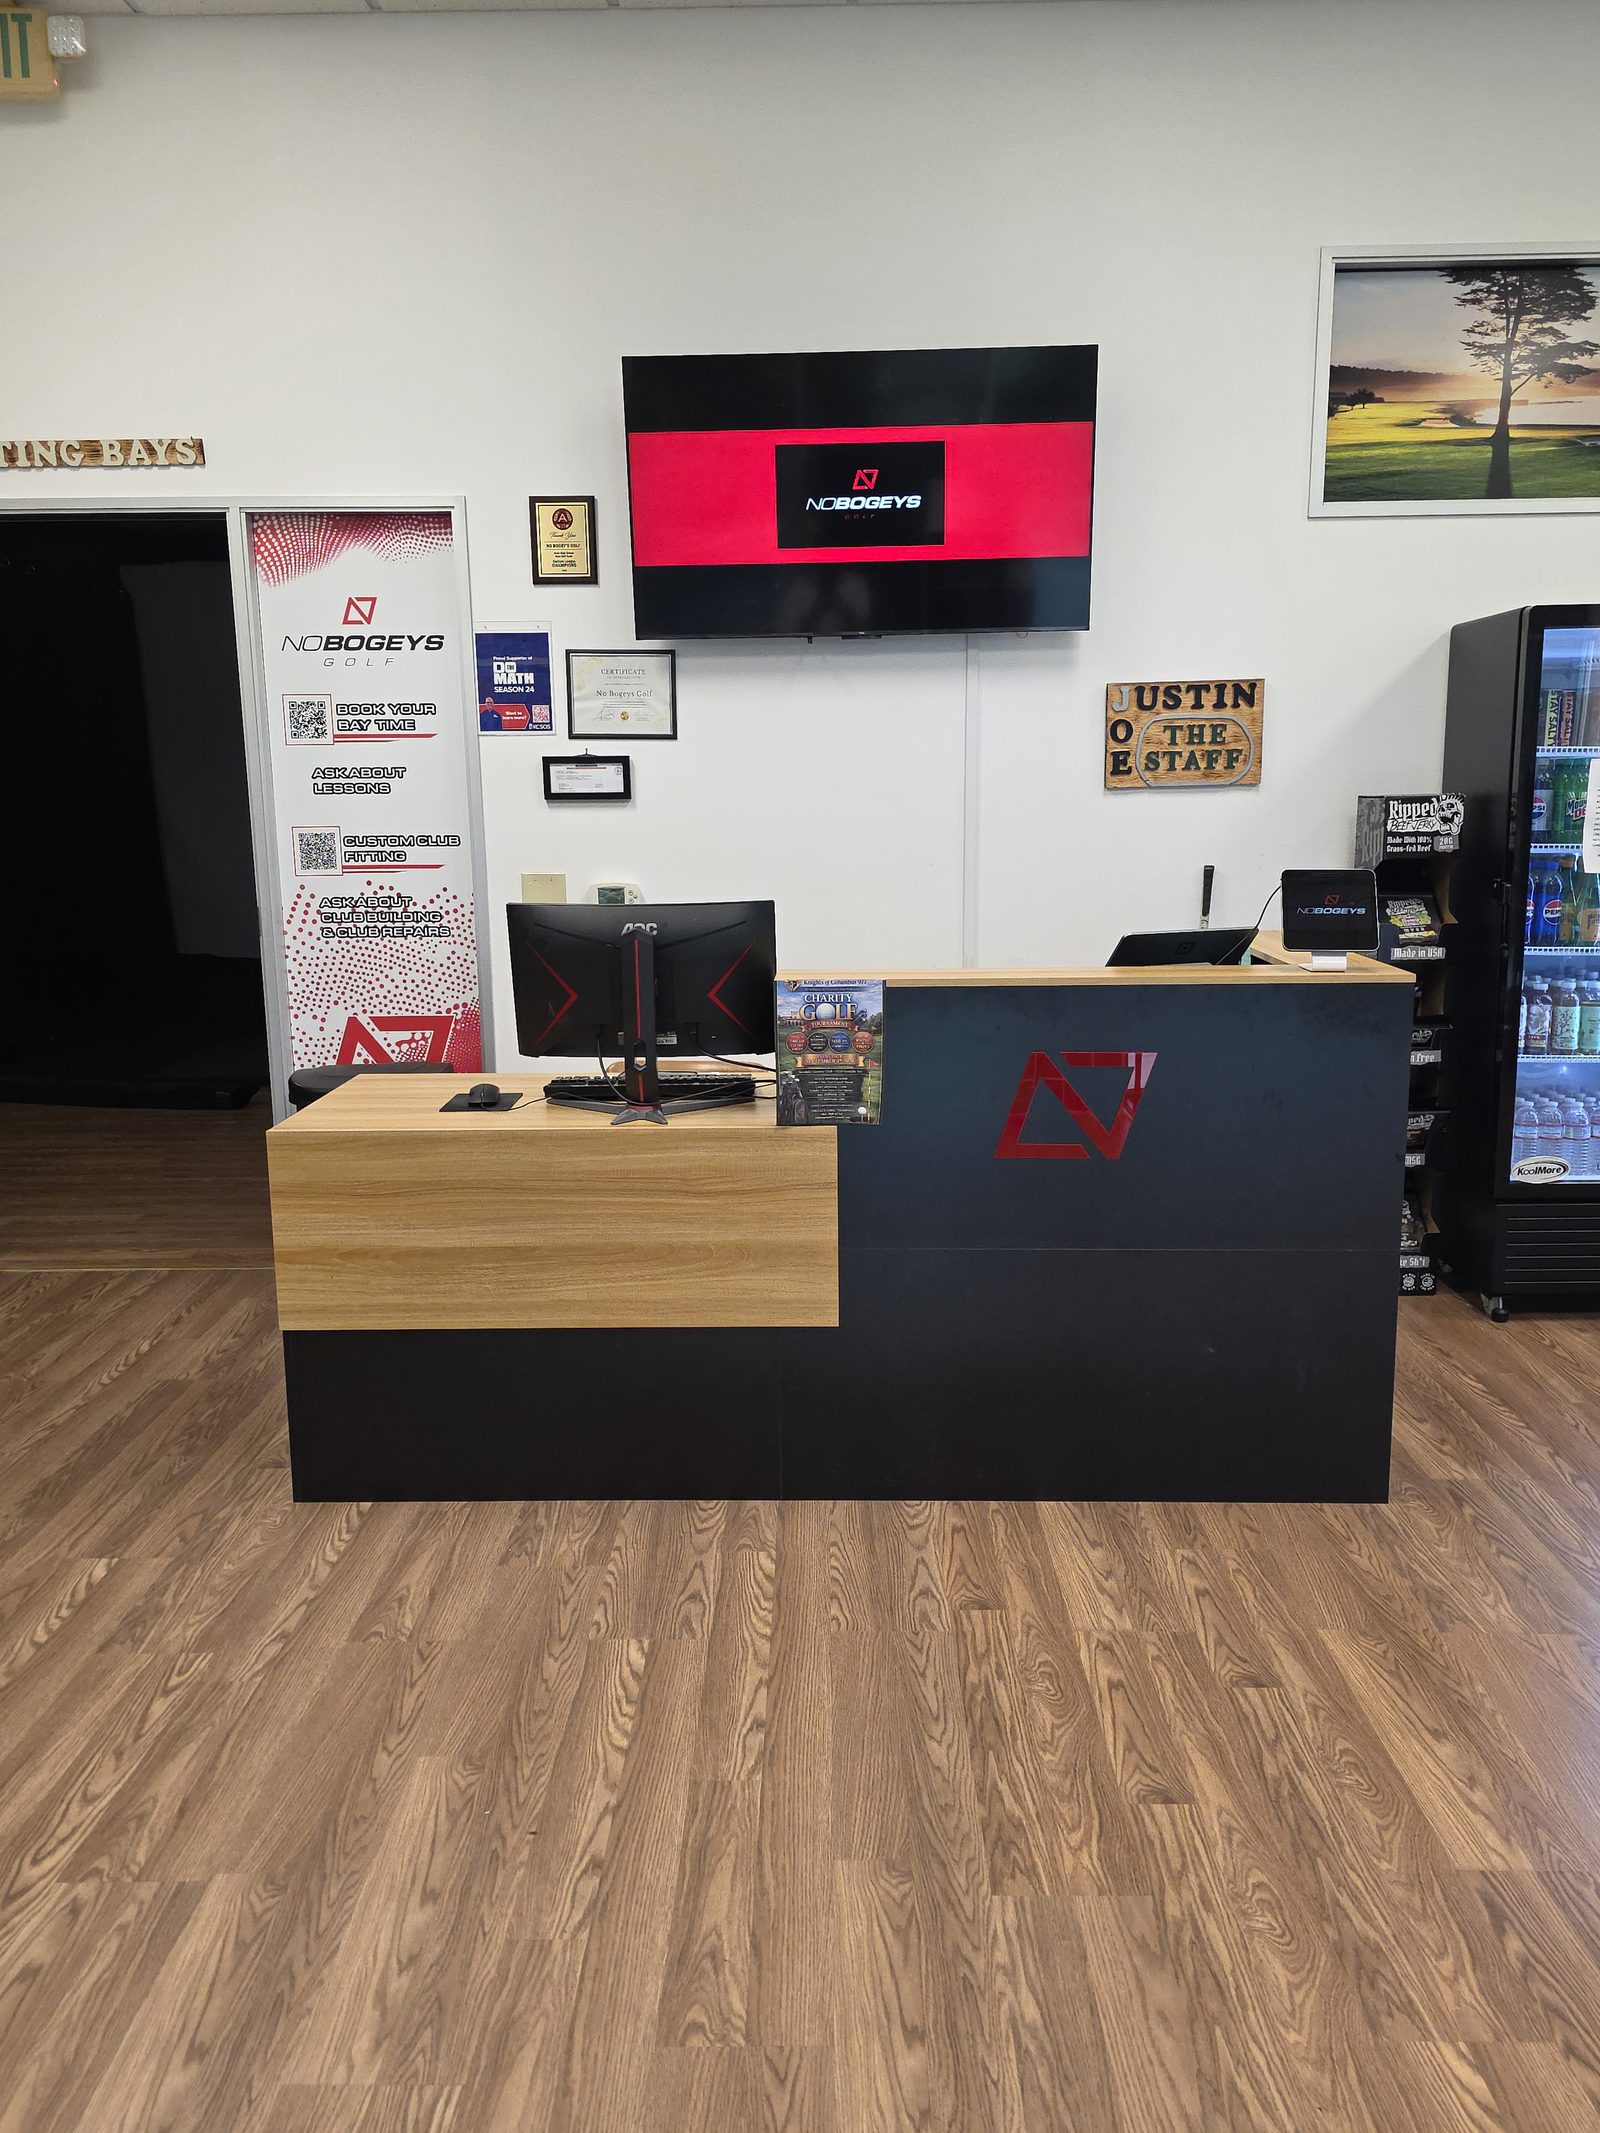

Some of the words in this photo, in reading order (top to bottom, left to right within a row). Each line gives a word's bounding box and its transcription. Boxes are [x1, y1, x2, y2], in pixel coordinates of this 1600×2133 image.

[100, 438, 197, 466] BAYS
[323, 658, 394, 667] GOLF
[493, 661, 516, 673] DO
[493, 672, 535, 685] MATH
[609, 690, 635, 698] Bogeys
[336, 703, 385, 716] BOOK
[389, 703, 437, 715] YOUR
[337, 719, 371, 731] BAY
[374, 719, 416, 731] TIME
[1163, 724, 1227, 746] THE
[1144, 749, 1243, 772] STAFF
[312, 768, 347, 779] ASK
[347, 767, 406, 779] ABOUT
[313, 783, 391, 794] LESSONS
[1389, 797, 1438, 821] Ripped
[343, 836, 415, 848] CUSTOM
[416, 835, 461, 847] CLUB
[1387, 836, 1403, 844] Made
[344, 850, 407, 863] FITTING
[319, 896, 354, 909] ASK
[354, 896, 413, 908] ABOUT
[320, 911, 365, 924] CLUB
[365, 911, 444, 923] BUILDING
[321, 926, 335, 938] &
[336, 926, 380, 938] CLUB
[381, 926, 451, 938] REPAIRS
[1393, 948, 1416, 959] Made
[1418, 948, 1426, 958] in
[1427, 947, 1443, 958] USA
[804, 993, 853, 1002] CHARITY
[800, 1003, 858, 1020] GOLF
[1517, 1166, 1562, 1176] KoolMore
